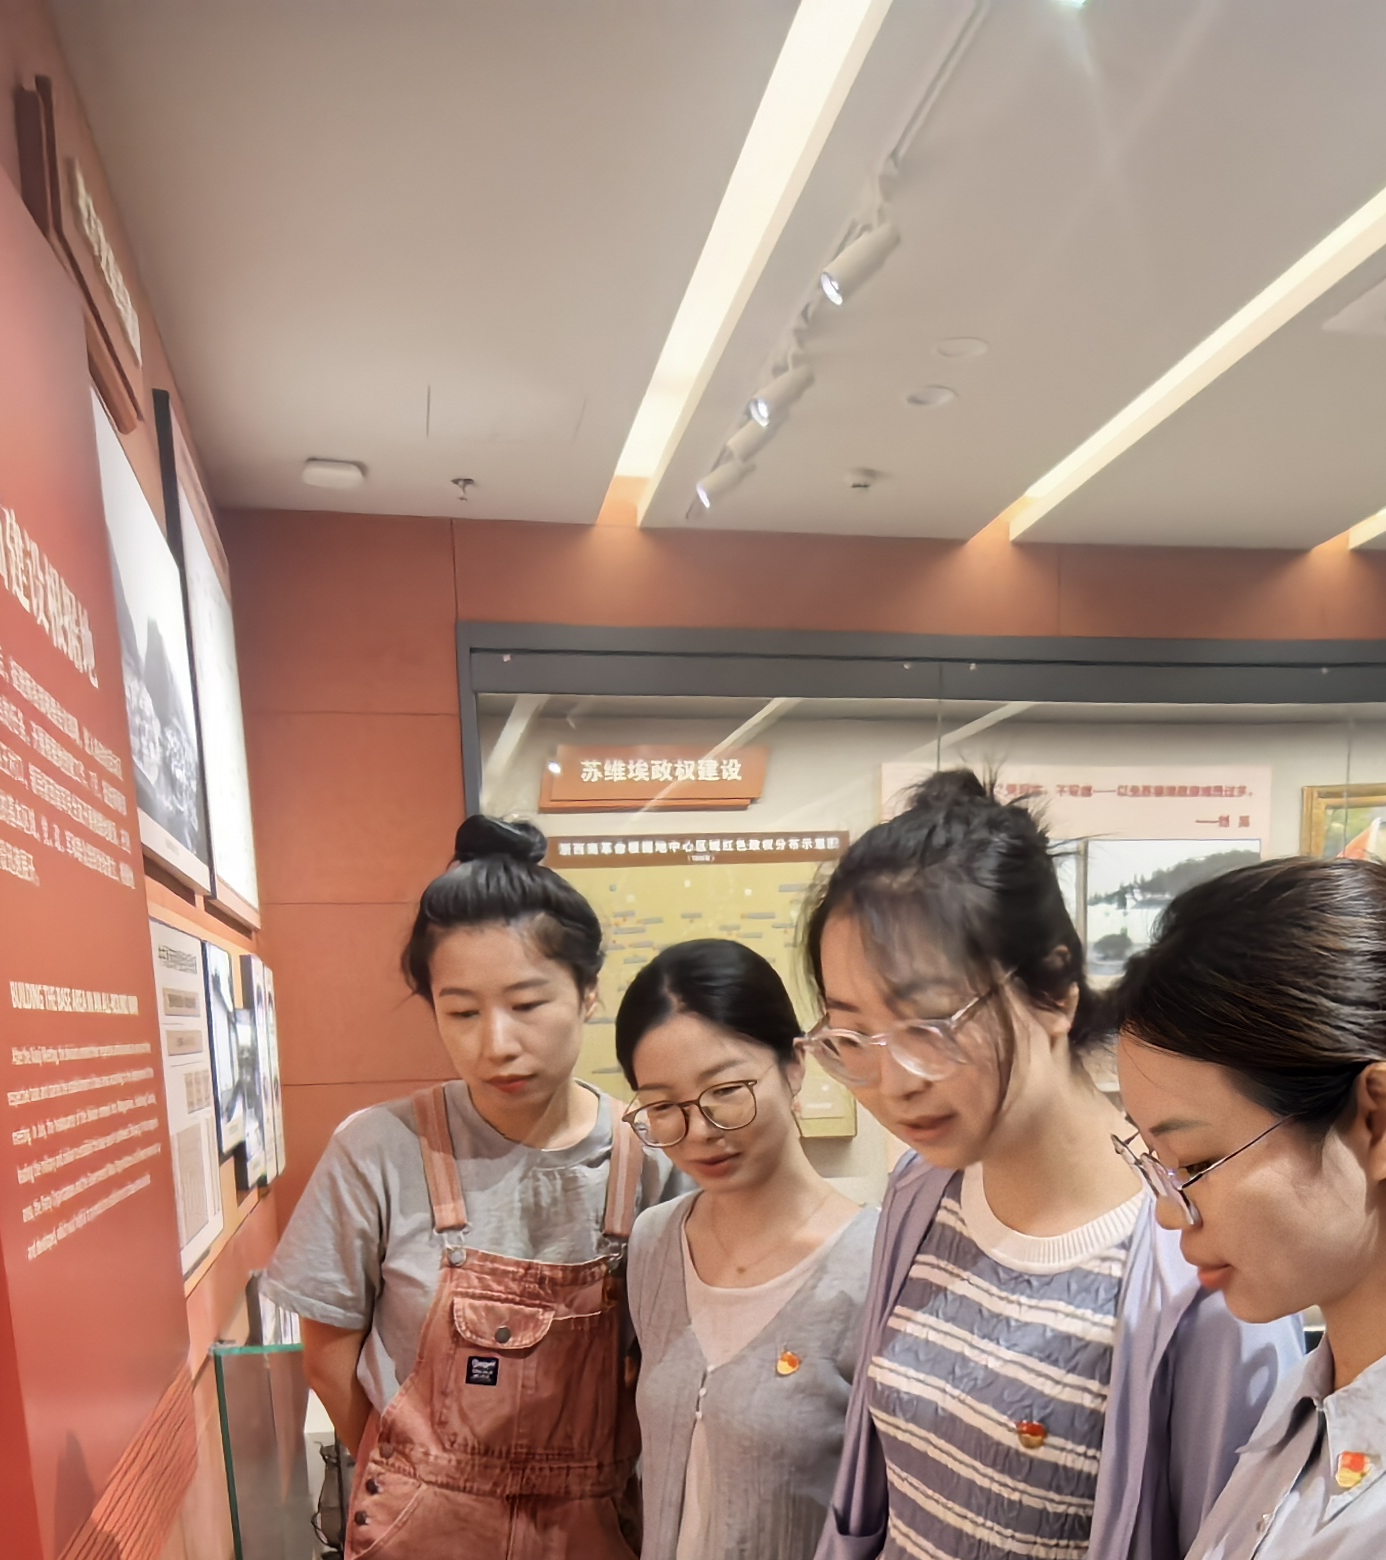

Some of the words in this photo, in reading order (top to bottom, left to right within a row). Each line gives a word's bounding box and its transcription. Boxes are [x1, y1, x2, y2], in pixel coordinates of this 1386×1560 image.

[580, 759, 743, 783] 苏维埃政权建设
[10, 981, 44, 1010] BUILDING
